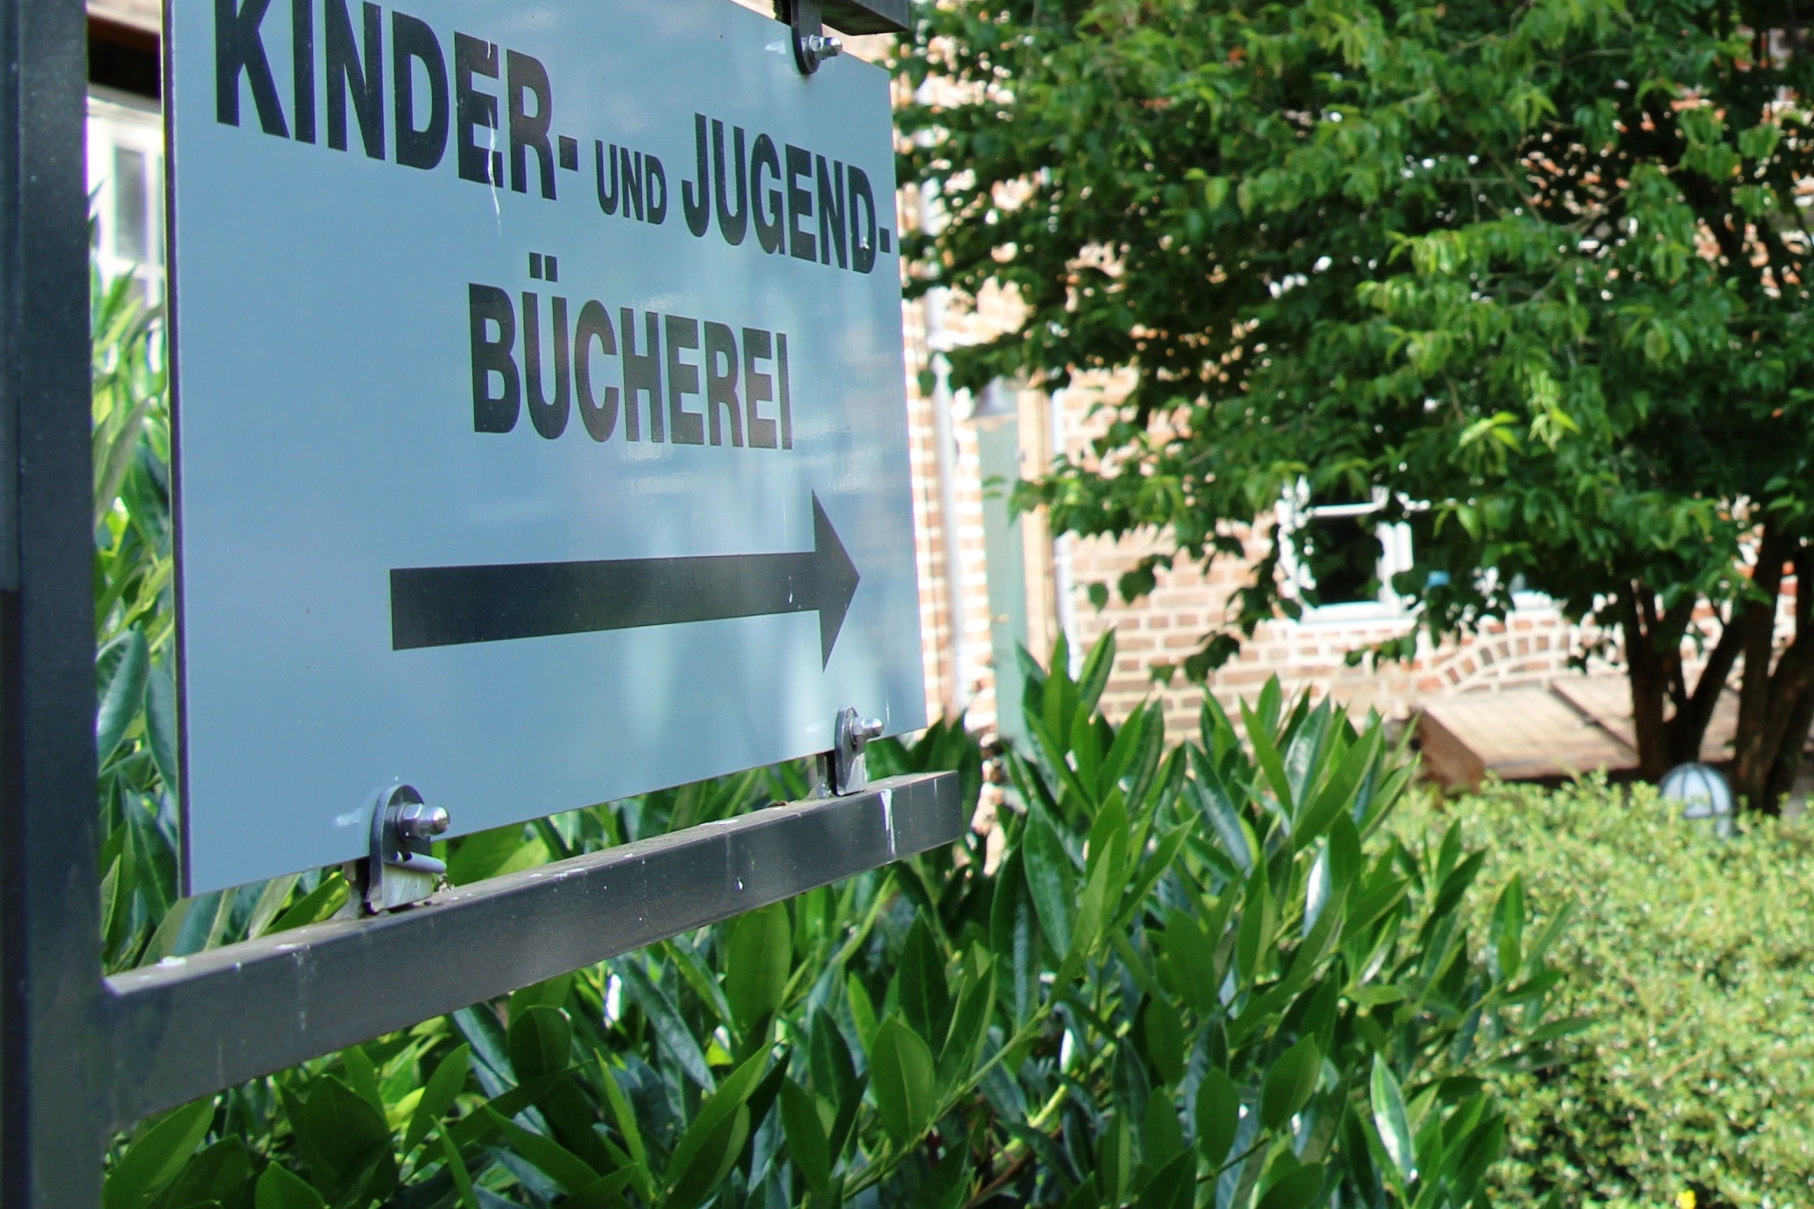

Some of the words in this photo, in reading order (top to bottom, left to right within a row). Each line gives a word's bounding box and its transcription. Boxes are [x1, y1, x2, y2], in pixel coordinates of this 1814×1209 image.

[596, 140, 668, 226] UND
[681, 113, 892, 275] JUGEND-
[468, 252, 793, 451] BÜCHEREI
